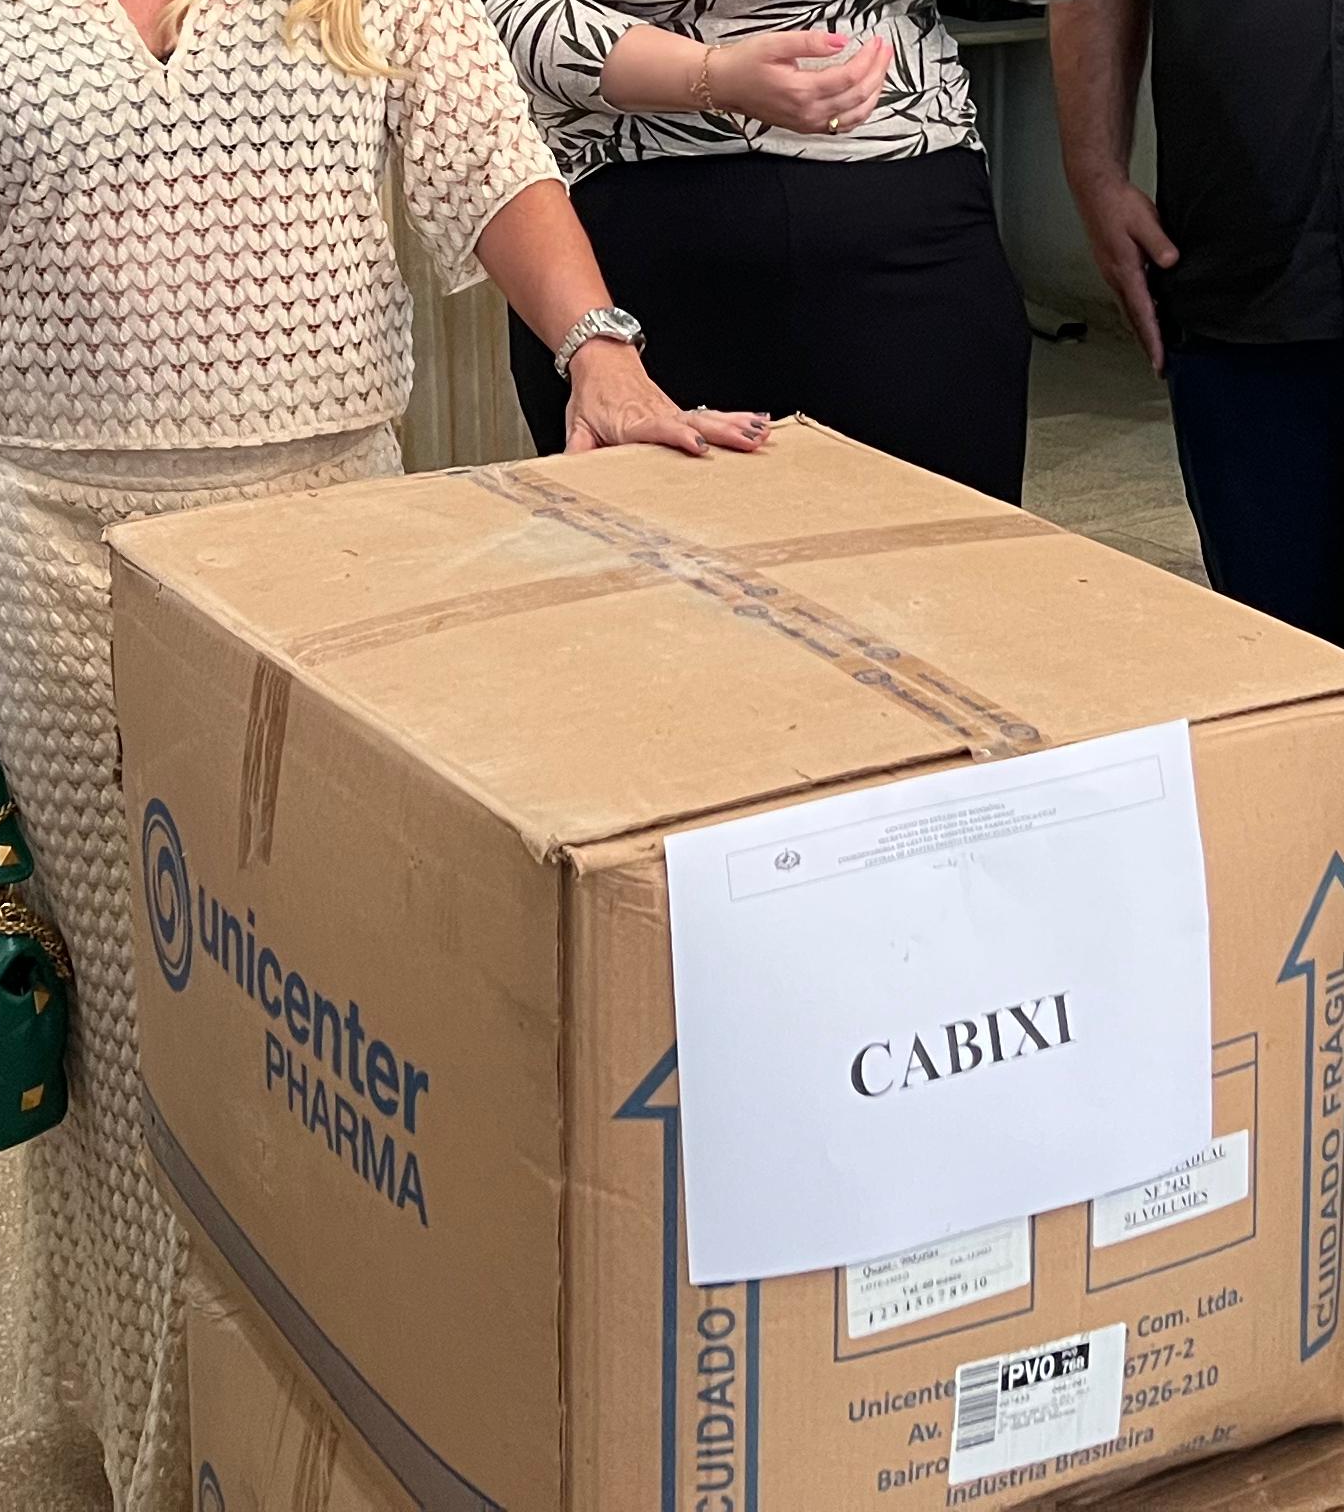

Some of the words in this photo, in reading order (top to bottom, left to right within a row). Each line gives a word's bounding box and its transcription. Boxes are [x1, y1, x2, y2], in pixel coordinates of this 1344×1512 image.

[197, 885, 430, 1136] unicenter
[849, 990, 1078, 1098] CABIXI
[264, 1032, 431, 1229] PHARMA
[1141, 1189, 1209, 1222] VOLUMES
[1315, 1129, 1344, 1330] CUIDADO
[926, 1294, 934, 1305] 6
[961, 1282, 969, 1293] 9
[973, 1275, 988, 1291] 10
[1137, 1309, 1191, 1338] Com.
[1197, 1286, 1244, 1319] Ltda.
[1009, 1354, 1055, 1391] PVO
[1124, 1337, 1195, 1379] 6777-2
[696, 1307, 736, 1512] CUIDADO
[848, 1378, 957, 1423] Unicente
[1121, 1364, 1219, 1417] 2926-210
[907, 1421, 942, 1446] Av.
[1055, 1425, 1155, 1473] Brasileira
[878, 1456, 950, 1492] Bairro
